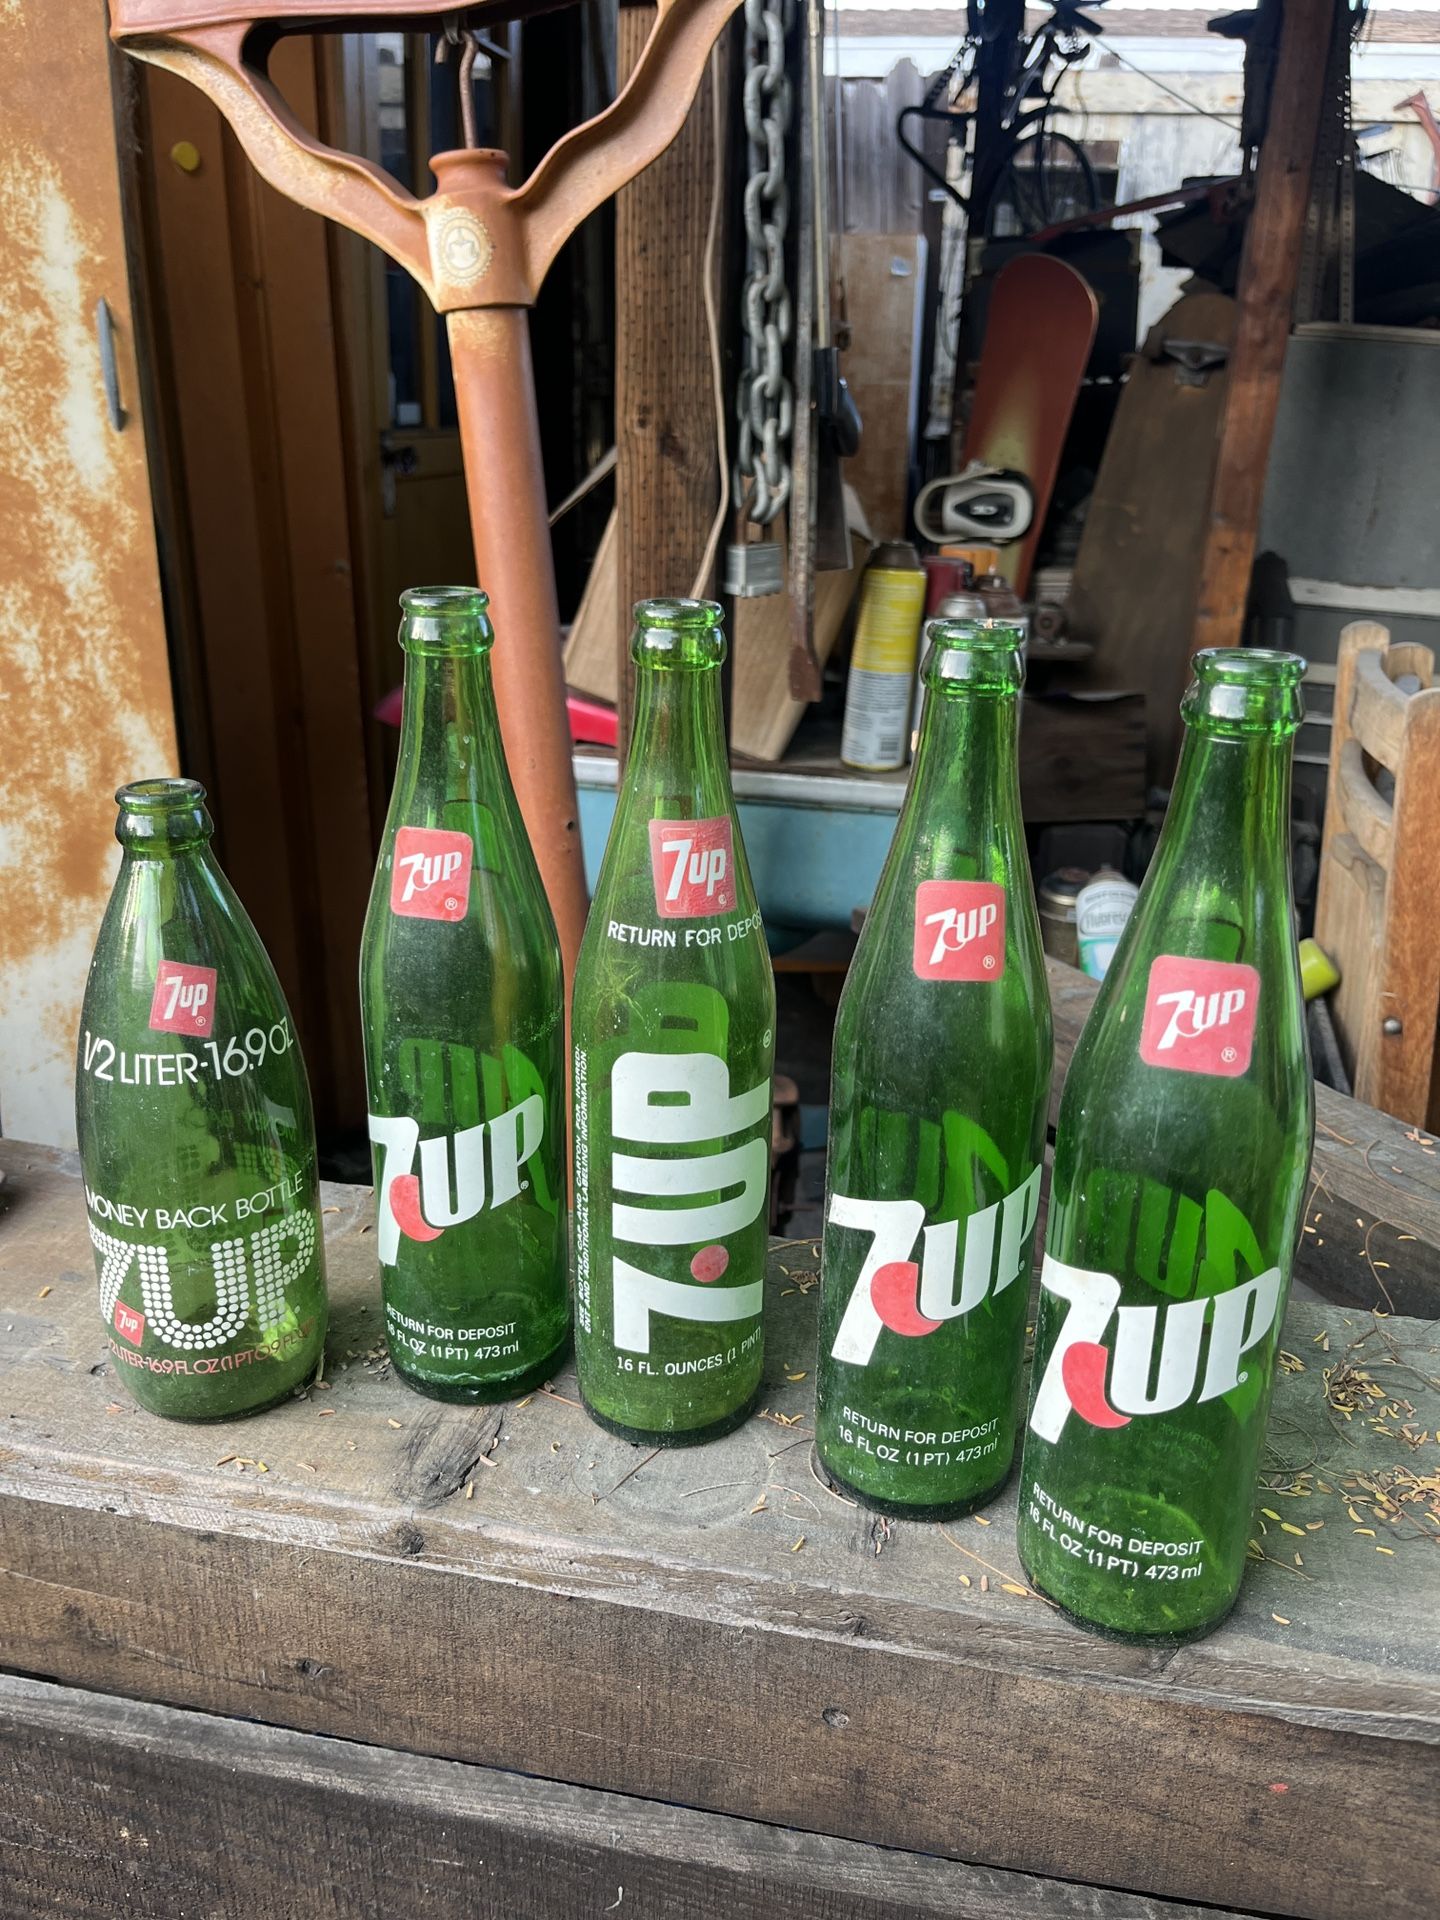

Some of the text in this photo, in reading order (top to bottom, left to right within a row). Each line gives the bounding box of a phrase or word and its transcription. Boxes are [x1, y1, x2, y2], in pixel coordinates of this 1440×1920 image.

[399, 851, 463, 902] 7UP
[662, 839, 728, 900] 7up
[607, 920, 677, 948] RETURN
[685, 928, 722, 948] FOR
[924, 903, 997, 966] 7UP
[1156, 988, 1245, 1050] 7UP
[85, 1170, 304, 1230] MONEY BACK BOTTLE
[368, 1094, 544, 1266] 7UP
[581, 1144, 589, 1203] LABELING
[582, 1206, 590, 1279] ADDITIONAL
[828, 1163, 1042, 1366] 7UP
[88, 1212, 315, 1350] 7UP
[577, 1255, 585, 1300] BOTTLE
[583, 1280, 591, 1307] AND
[387, 1302, 517, 1340] RETURN FOR DEPOSIT
[584, 1307, 592, 1334] ENT
[1029, 1252, 1281, 1444] 7UP
[617, 1356, 633, 1371] 16
[638, 1361, 659, 1376] FL.
[665, 1353, 723, 1376] OUNCES
[727, 1348, 737, 1364] (1
[843, 1405, 999, 1445] RETURN FOR DEPOSIT
[1029, 1501, 1040, 1524] 16
[1033, 1481, 1204, 1557] RETURN FOR DEPOSIT
